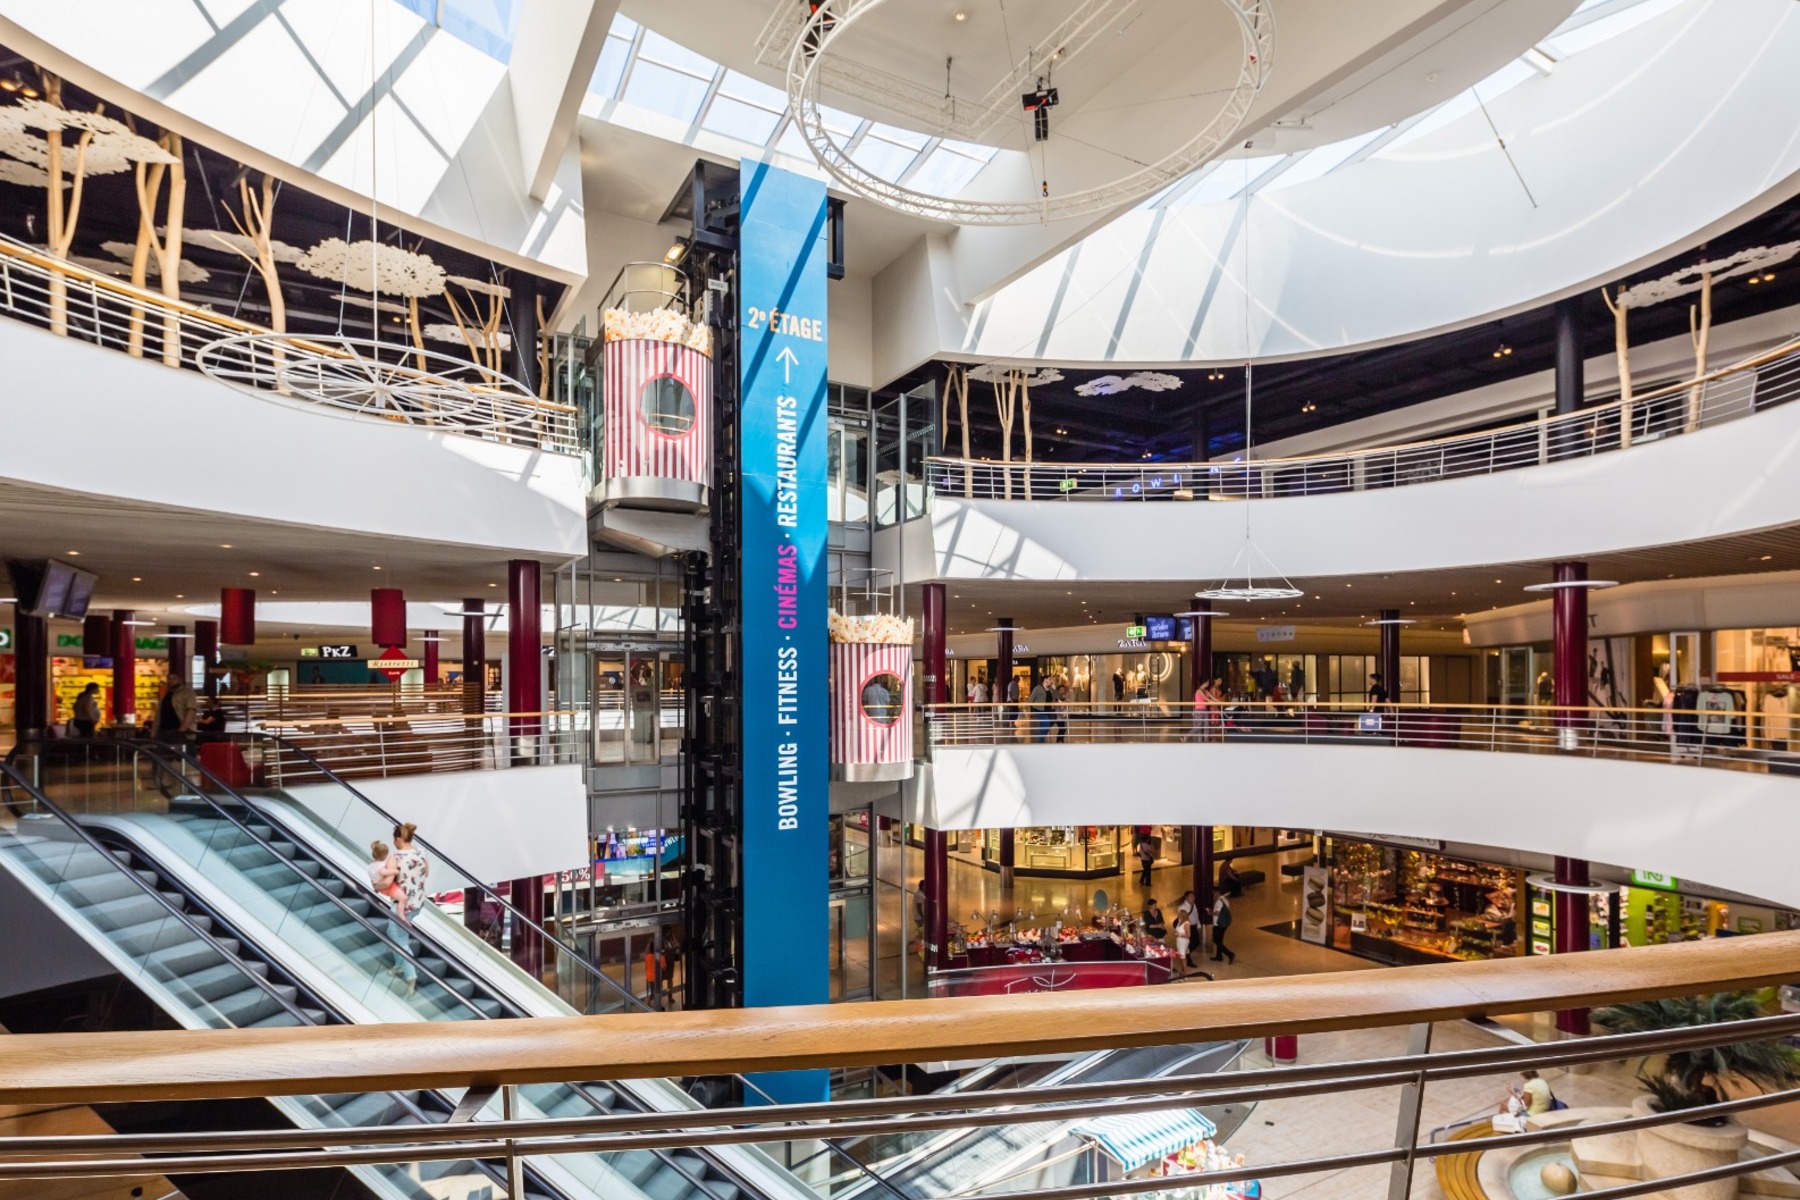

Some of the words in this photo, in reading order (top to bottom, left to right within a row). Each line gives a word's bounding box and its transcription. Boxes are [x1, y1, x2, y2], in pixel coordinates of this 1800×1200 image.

[769, 306, 823, 342] ÉTAGE
[776, 395, 798, 528] RESTAURANTS
[773, 544, 798, 629] CINÉMAS
[777, 647, 798, 725] FITNESS
[778, 743, 799, 831] BOWLING
